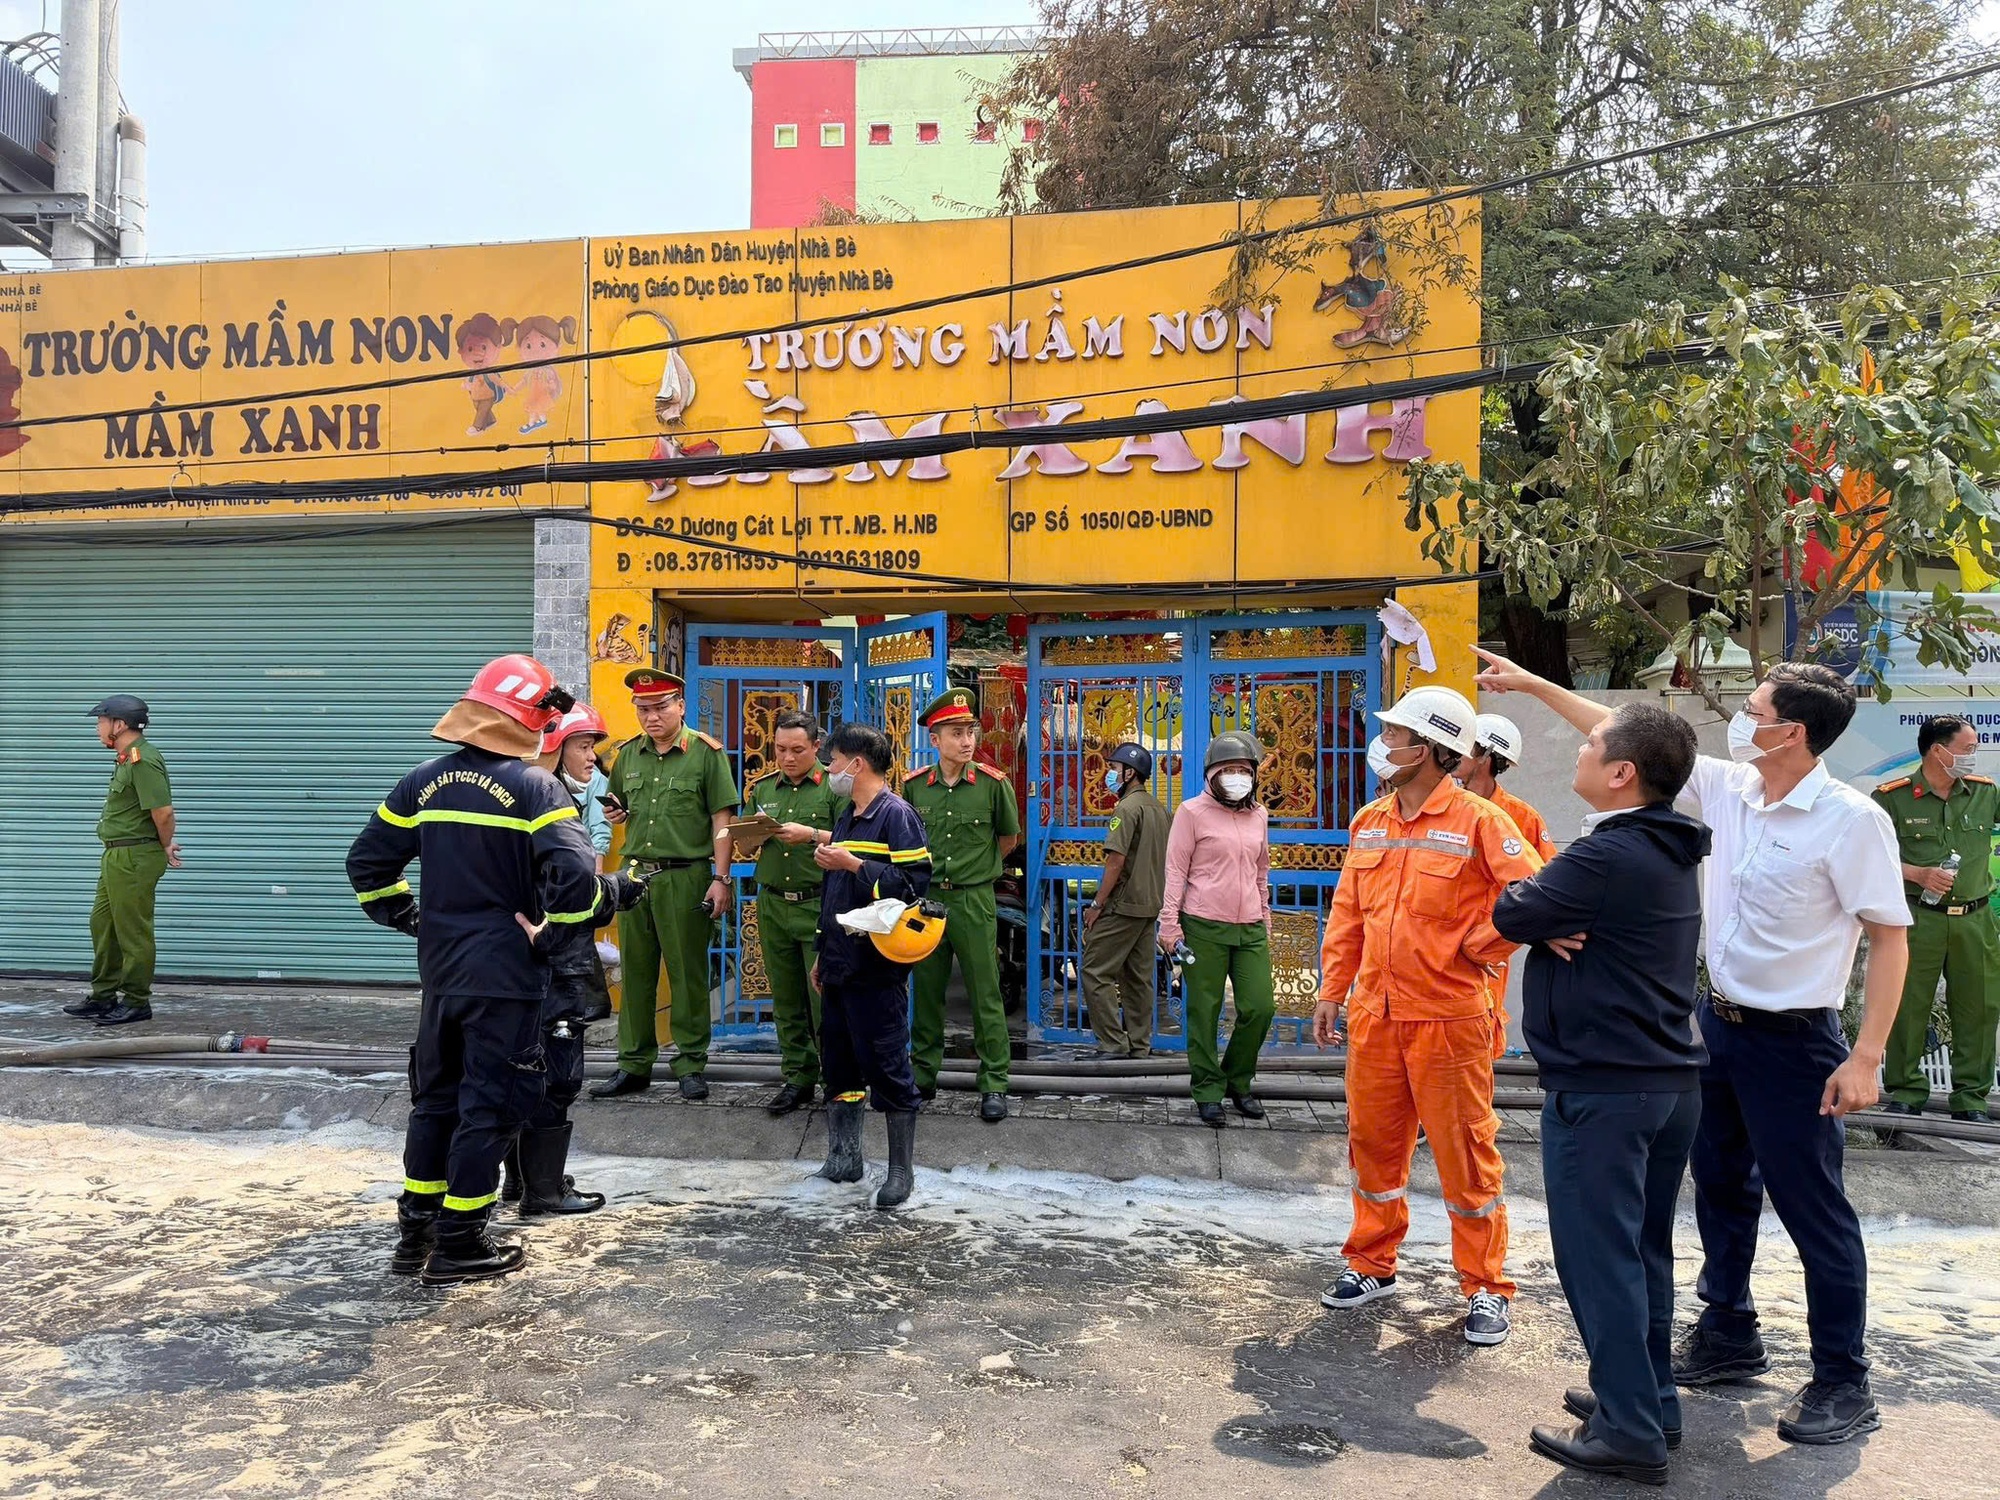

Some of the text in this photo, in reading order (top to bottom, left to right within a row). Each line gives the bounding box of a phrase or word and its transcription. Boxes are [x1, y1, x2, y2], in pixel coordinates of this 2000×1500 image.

[628, 246, 660, 266] Ban
[663, 242, 705, 264] Nhân
[711, 240, 741, 262] Dân
[746, 239, 796, 265] Huyện
[800, 236, 830, 259] Nhà
[835, 235, 857, 258] Bè
[0, 283, 41, 296] NHÀ BÈ
[592, 276, 640, 303] Phòng
[645, 275, 680, 298] Giáo
[684, 275, 715, 301] Dục
[718, 271, 749, 295] Đào
[788, 270, 836, 297] Huyện
[839, 269, 870, 291] Nhà
[873, 267, 894, 290] Bè
[25, 299, 37, 311] BÈ
[23, 299, 453, 377] TRƯỜNG MẦM NON
[988, 288, 1125, 365] MẦM
[1148, 305, 1277, 356] NON
[104, 390, 381, 459] MẦM XANH
[646, 379, 1433, 503] ẦM XANH
[681, 516, 737, 541] Dương
[744, 514, 774, 536] Cát
[781, 516, 812, 540] Lợi
[893, 513, 937, 535] H.NB
[1011, 511, 1036, 532] GP
[1045, 505, 1069, 531] Số
[1900, 711, 1941, 726] PHÒN
[1976, 714, 2000, 727] DỤC
[437, 771, 454, 787] SÁT
[455, 771, 478, 784] PCCC
[489, 783, 516, 808] CNCH
